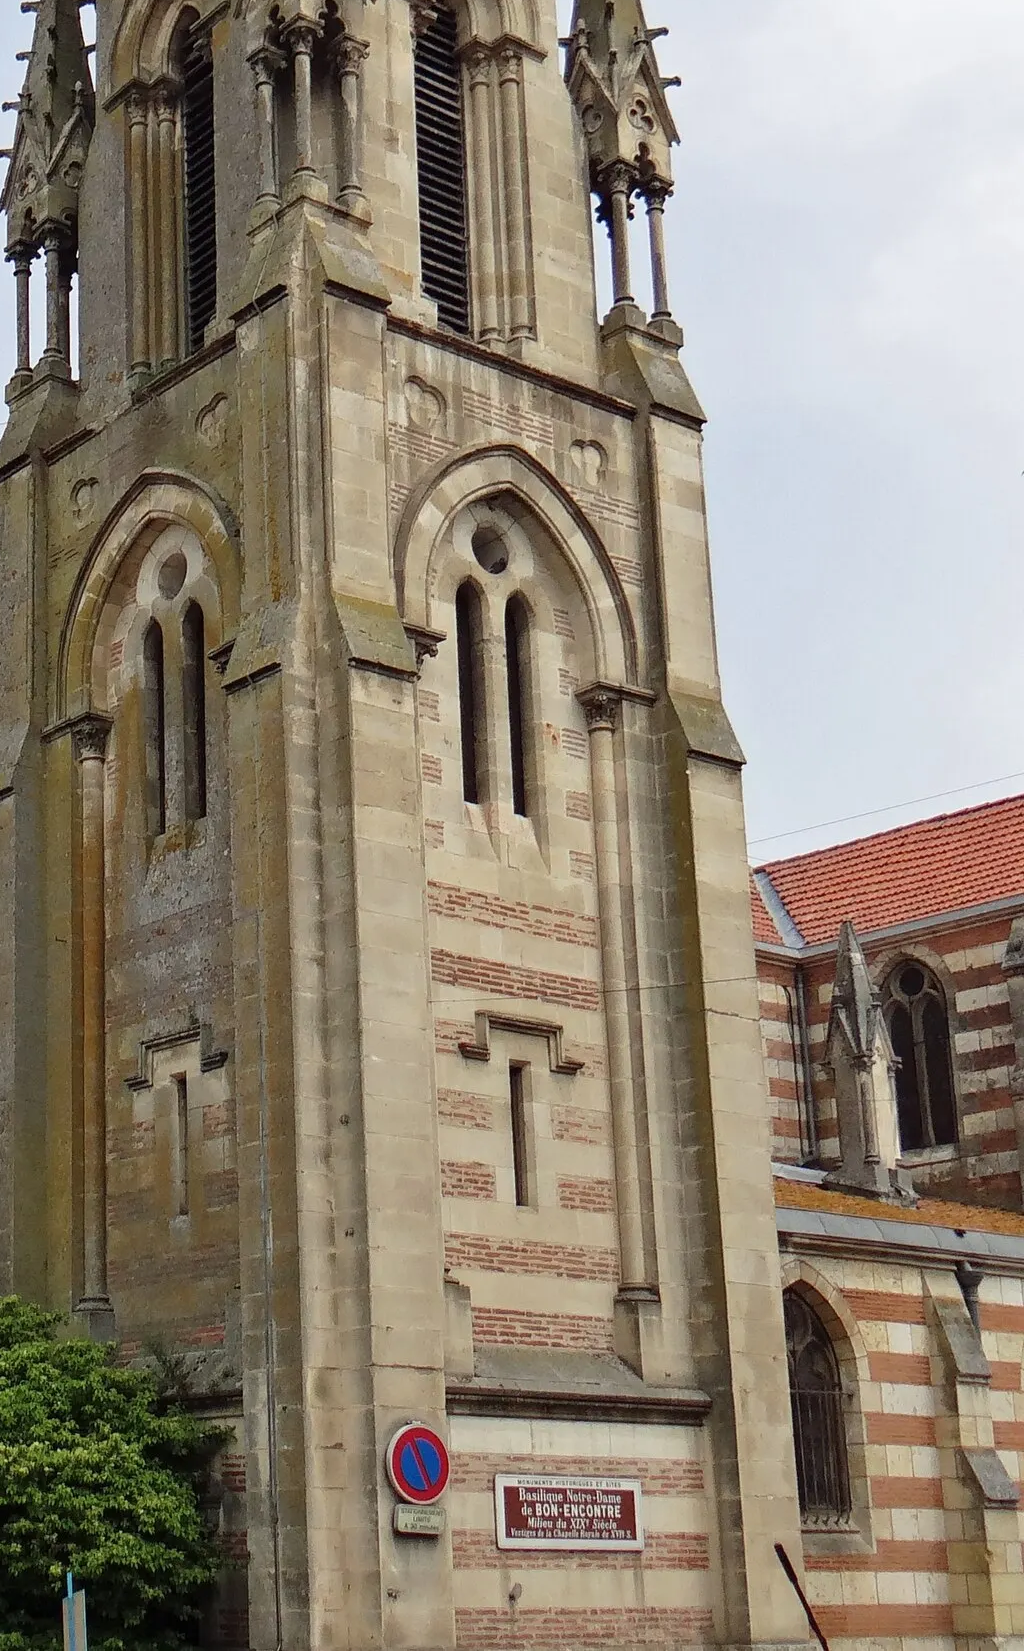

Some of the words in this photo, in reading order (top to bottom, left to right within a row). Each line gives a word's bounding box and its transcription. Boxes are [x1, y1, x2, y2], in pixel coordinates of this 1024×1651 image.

[519, 1487, 563, 1504] Basilique
[521, 1502, 533, 1516] de
[527, 1517, 553, 1529] Milieu
[556, 1518, 567, 1529] du
[592, 1518, 617, 1530] Siècle
[553, 1529, 579, 1539] Chapelle
